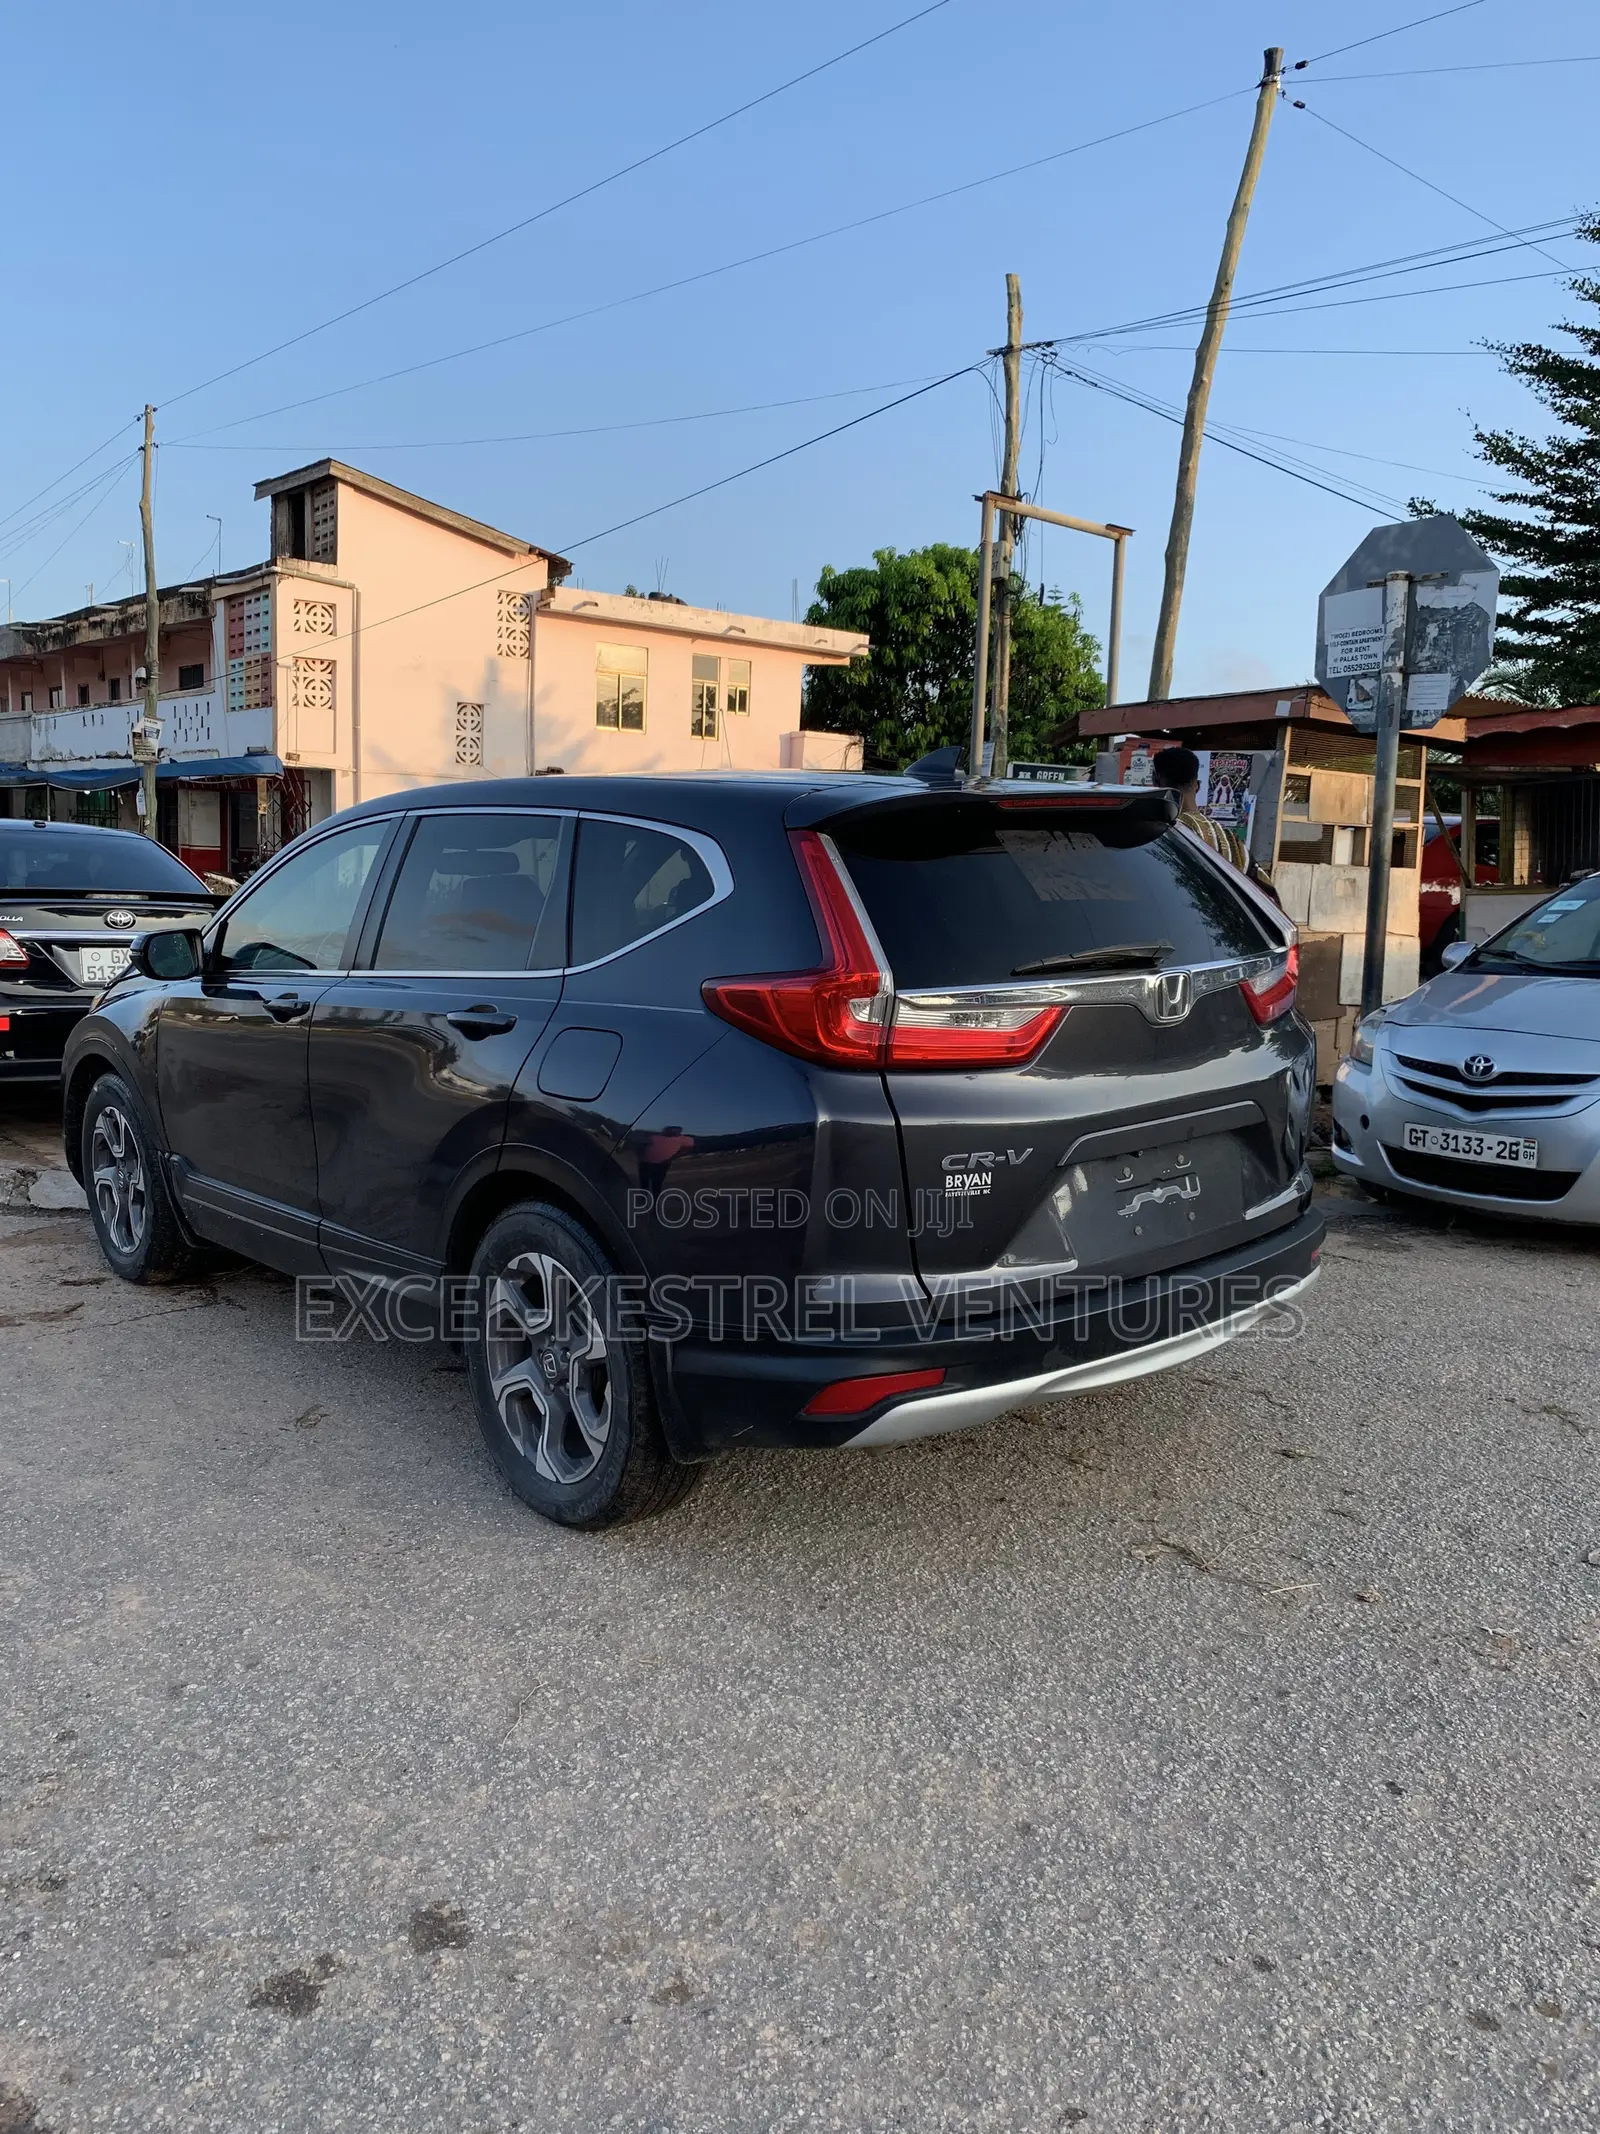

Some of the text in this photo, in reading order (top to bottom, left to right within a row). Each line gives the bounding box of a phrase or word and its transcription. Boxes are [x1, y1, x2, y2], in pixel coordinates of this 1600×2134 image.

[1351, 628, 1383, 637] BEDROOMS
[1209, 759, 1247, 769] BIRTHDAY
[1036, 770, 1065, 780] GREEN
[1408, 1128, 1429, 1148] GT
[941, 1148, 1034, 1171] CR-V
[1523, 1150, 1535, 1160] GH
